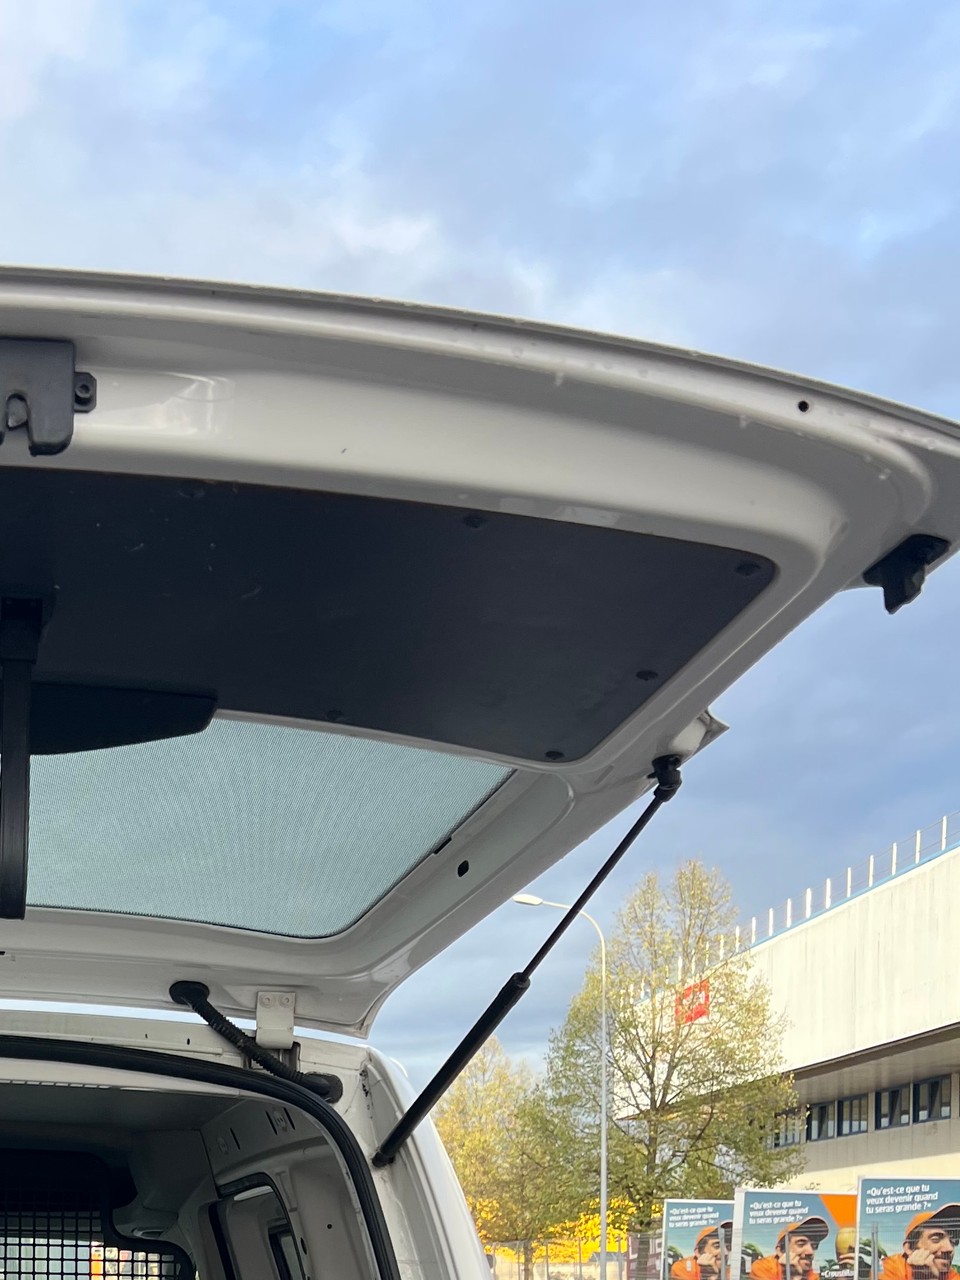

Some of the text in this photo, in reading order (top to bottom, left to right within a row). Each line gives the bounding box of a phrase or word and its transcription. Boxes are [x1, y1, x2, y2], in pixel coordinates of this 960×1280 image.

[906, 1185, 920, 1194] que
[885, 1194, 912, 1203] devenir
[914, 1192, 938, 1201] quand
[896, 1202, 921, 1212] grande
